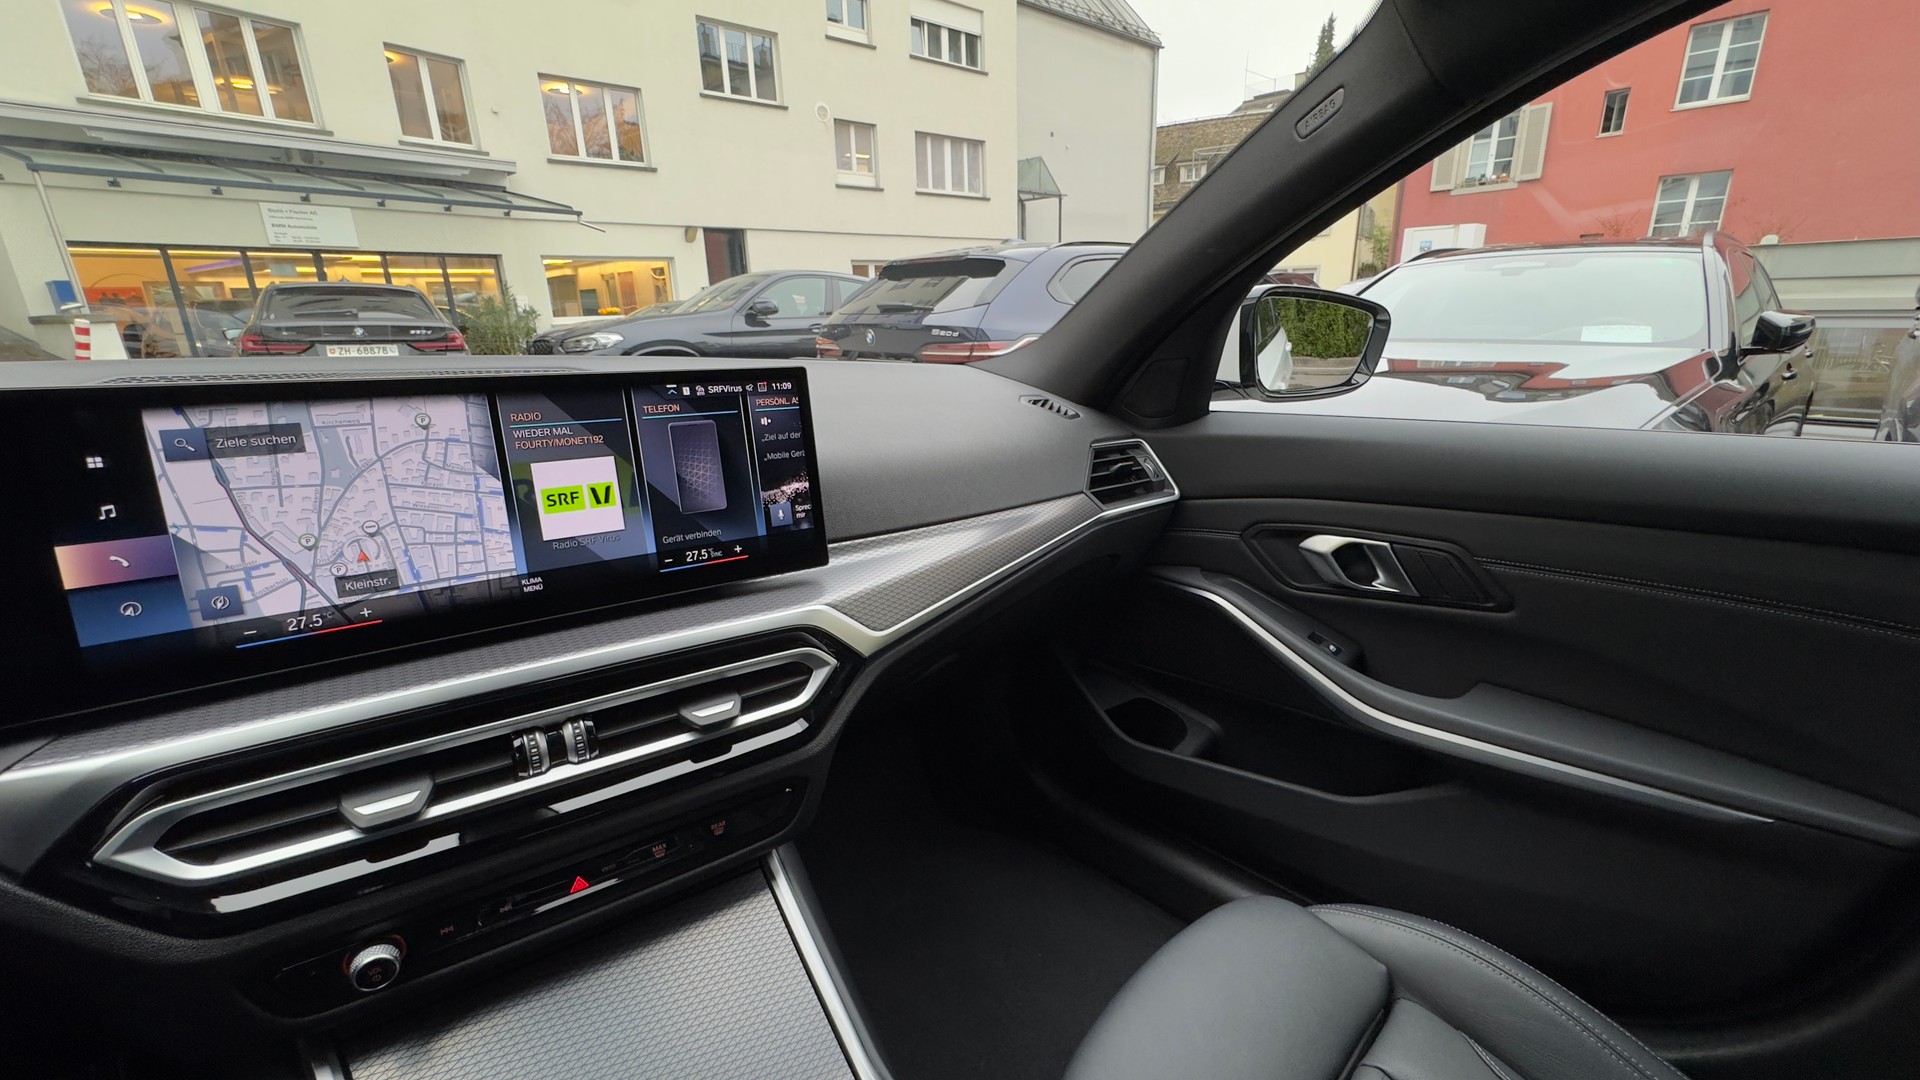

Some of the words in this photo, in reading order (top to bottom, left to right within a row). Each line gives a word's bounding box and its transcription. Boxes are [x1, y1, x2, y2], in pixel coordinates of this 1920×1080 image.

[1304, 98, 1336, 131] AIRBAG
[338, 346, 351, 356] ZH
[356, 346, 389, 355] 68878
[708, 384, 743, 394] SRFVirus
[771, 382, 792, 390] 11:09
[756, 397, 790, 406] PERSÖNL.
[643, 403, 681, 414] TELEFON
[510, 411, 542, 422] RADIO
[513, 427, 552, 439] WIEDER
[552, 427, 574, 436] MAL
[777, 432, 789, 440] auf
[216, 438, 248, 449] Ziele
[250, 434, 297, 447] suchen
[515, 435, 605, 450] FOURTY/MONET192
[546, 491, 580, 508] SRF
[552, 540, 579, 550] Radio
[579, 536, 598, 546] SRF
[599, 534, 622, 544] Virus
[662, 534, 684, 545] Gerät
[684, 529, 722, 541] verbinden
[686, 549, 708, 562] 27.5
[345, 577, 392, 591] Kleinstr.
[521, 576, 543, 586] KLIMA
[523, 583, 544, 593] MENÜ
[286, 613, 323, 632] 27.5
[710, 820, 726, 831] REAR
[652, 842, 667, 853] MAX
